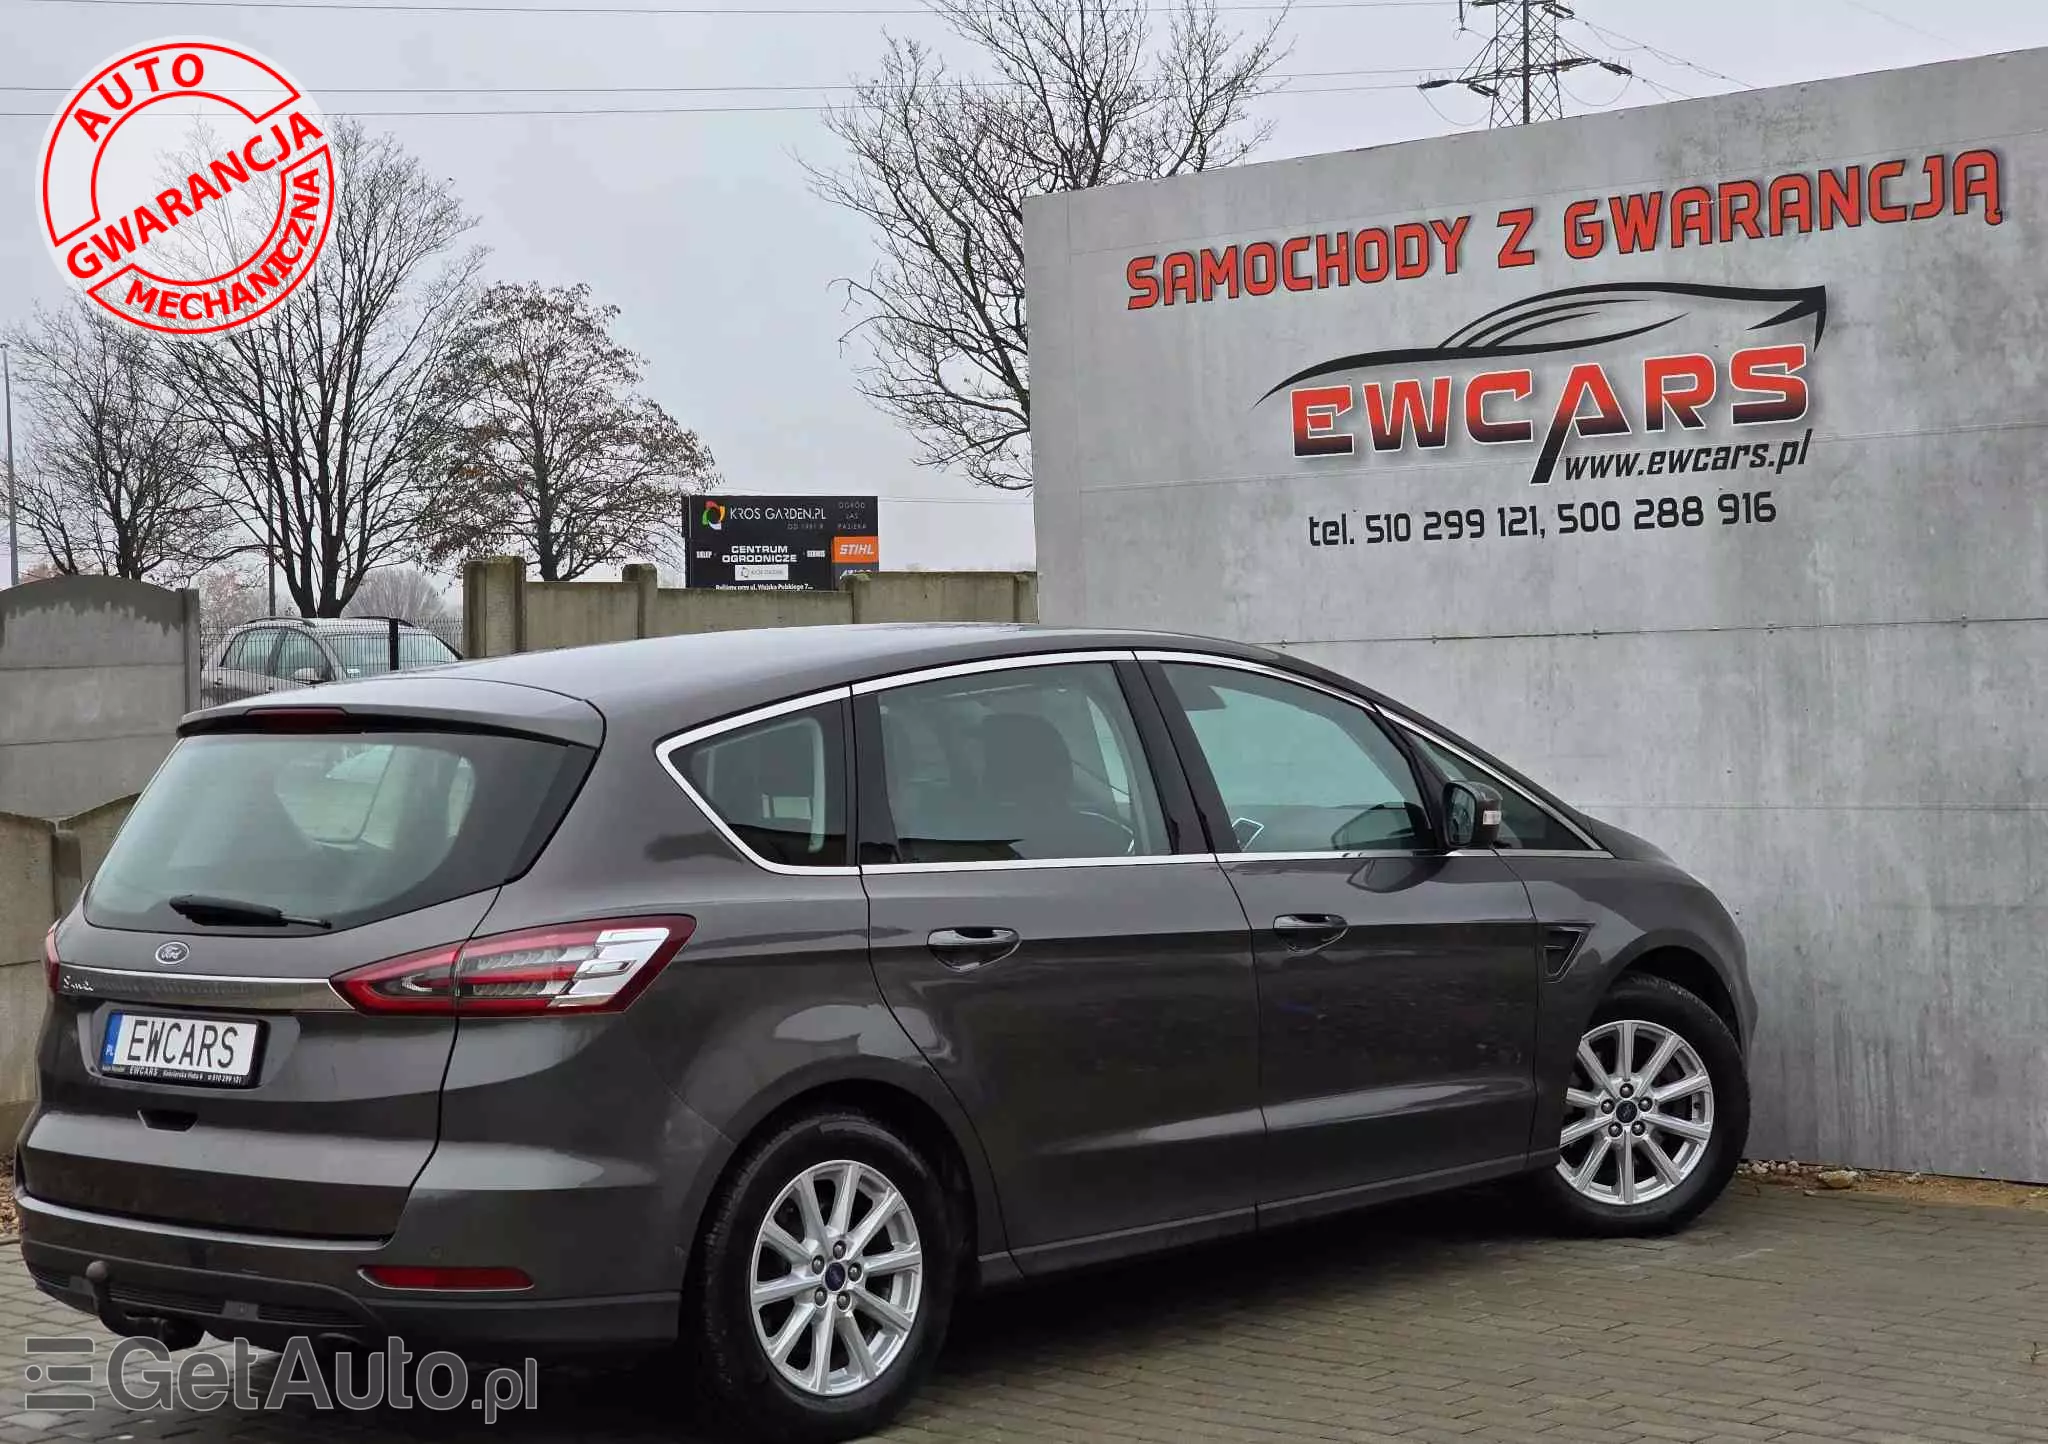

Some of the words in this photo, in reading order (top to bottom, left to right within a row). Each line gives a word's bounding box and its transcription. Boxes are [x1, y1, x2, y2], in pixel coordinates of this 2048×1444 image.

[1127, 217, 1470, 309] SAMOCHODY
[1497, 208, 1535, 268] Z
[1564, 150, 2003, 260] GWARANCJĄ
[1291, 343, 1808, 485] EWCARS
[1564, 429, 1813, 480] www.ewcars.pl
[730, 507, 761, 520] KROS
[765, 507, 827, 520] GARDEN.PL
[1309, 515, 1355, 546] tel.
[1366, 512, 1411, 543] 510
[1423, 508, 1485, 540] 299
[1498, 504, 1546, 540] 121,
[1558, 500, 1619, 532] 500
[1634, 496, 1704, 528] 288
[1718, 491, 1777, 524] 916
[722, 554, 797, 563] OGRODNICZE
[731, 545, 788, 554] CENTRUM
[840, 543, 874, 555] STIHL
[127, 1019, 239, 1068] EWCARS
